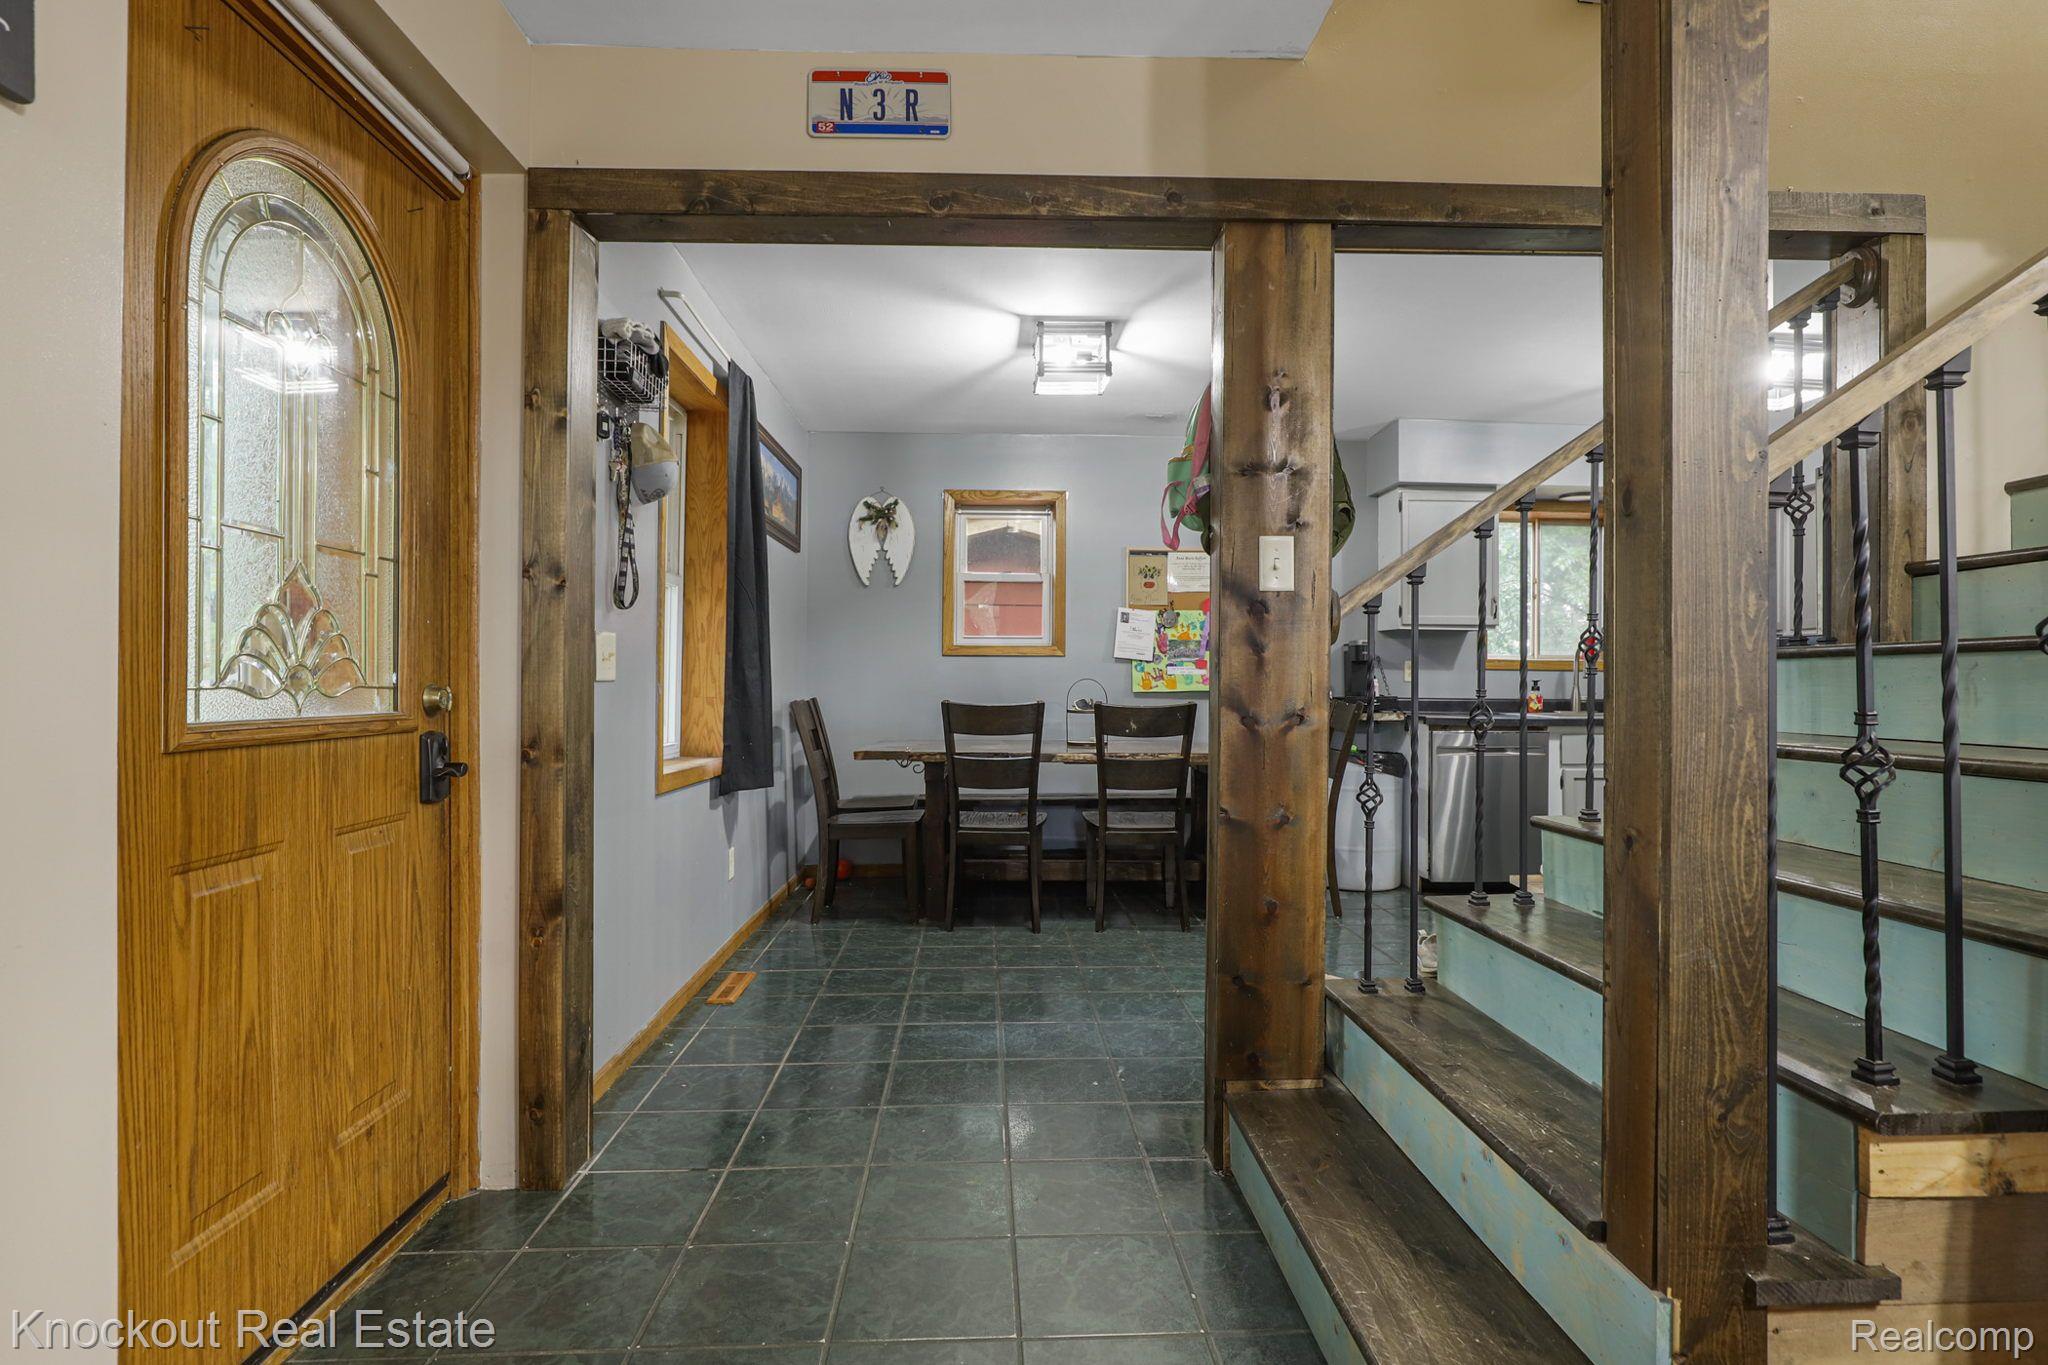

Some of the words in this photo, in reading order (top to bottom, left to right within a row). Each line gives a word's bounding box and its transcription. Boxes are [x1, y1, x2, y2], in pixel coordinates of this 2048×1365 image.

[840, 88, 853, 121] N
[872, 88, 886, 121] 3
[905, 88, 919, 122] R
[817, 122, 834, 132] 52
